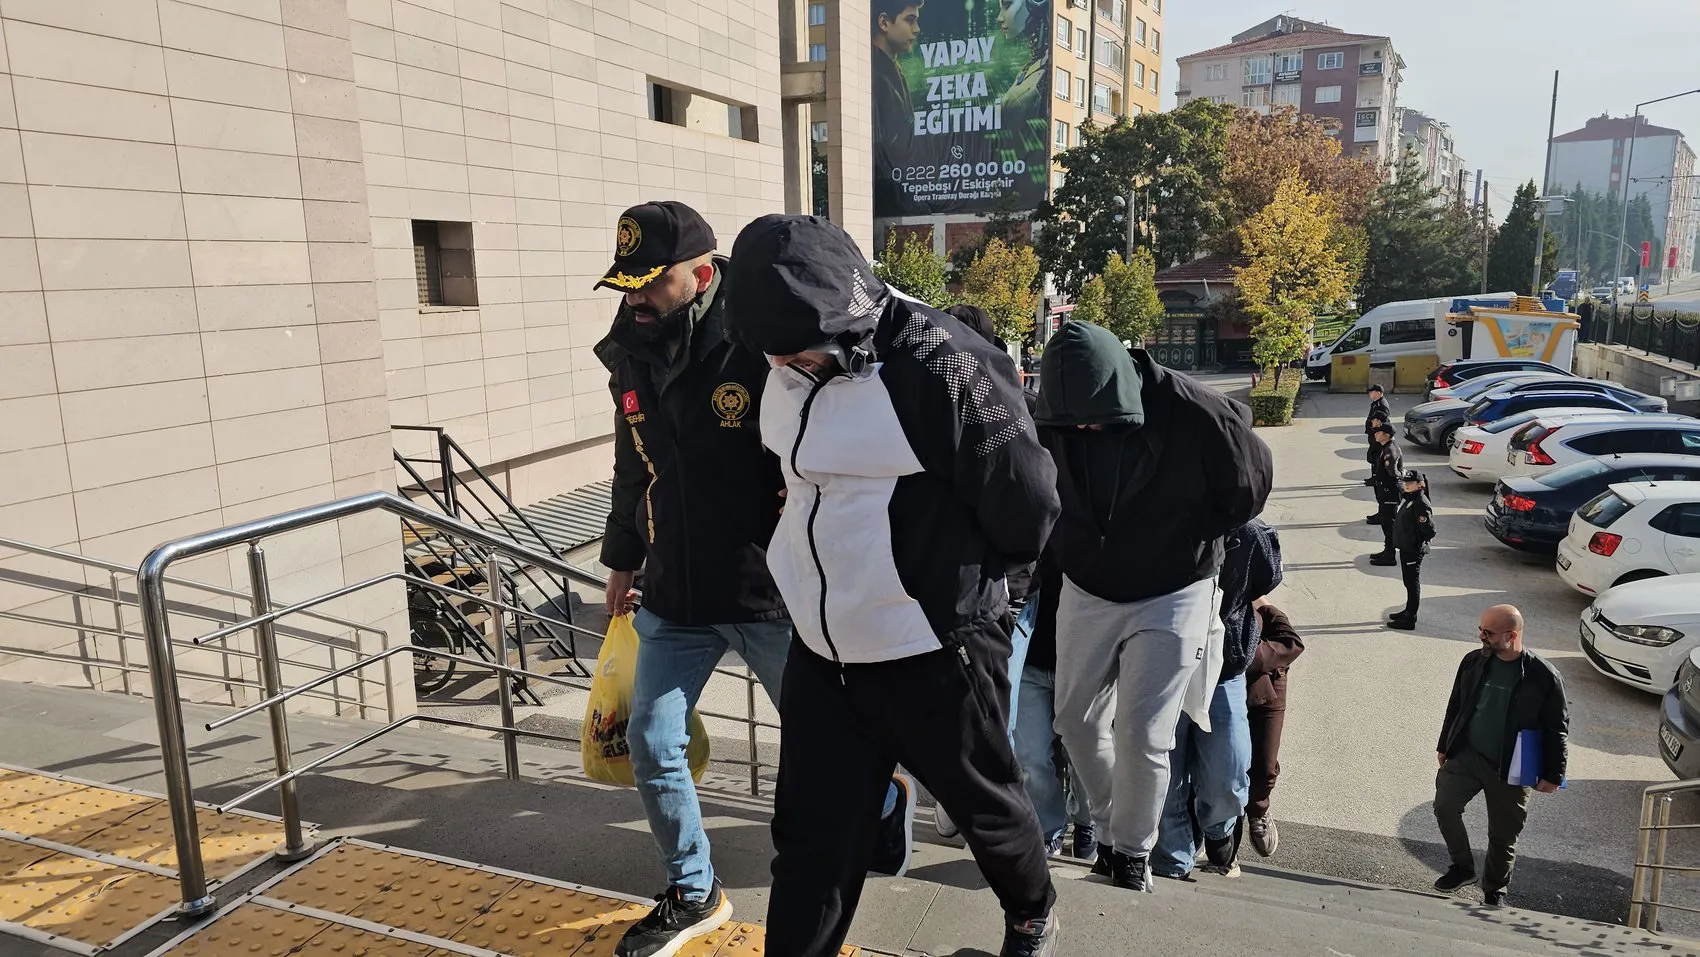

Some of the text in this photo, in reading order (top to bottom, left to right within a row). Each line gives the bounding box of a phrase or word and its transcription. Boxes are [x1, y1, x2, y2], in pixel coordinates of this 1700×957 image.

[920, 37, 995, 68] YAPAY
[926, 72, 988, 102] ZEKA
[914, 98, 1001, 135] EĞİTİMİ
[892, 159, 1026, 181] 0 222 260 00 00
[901, 181, 951, 194] Tepebaşı
[720, 420, 742, 428] AHLAK
